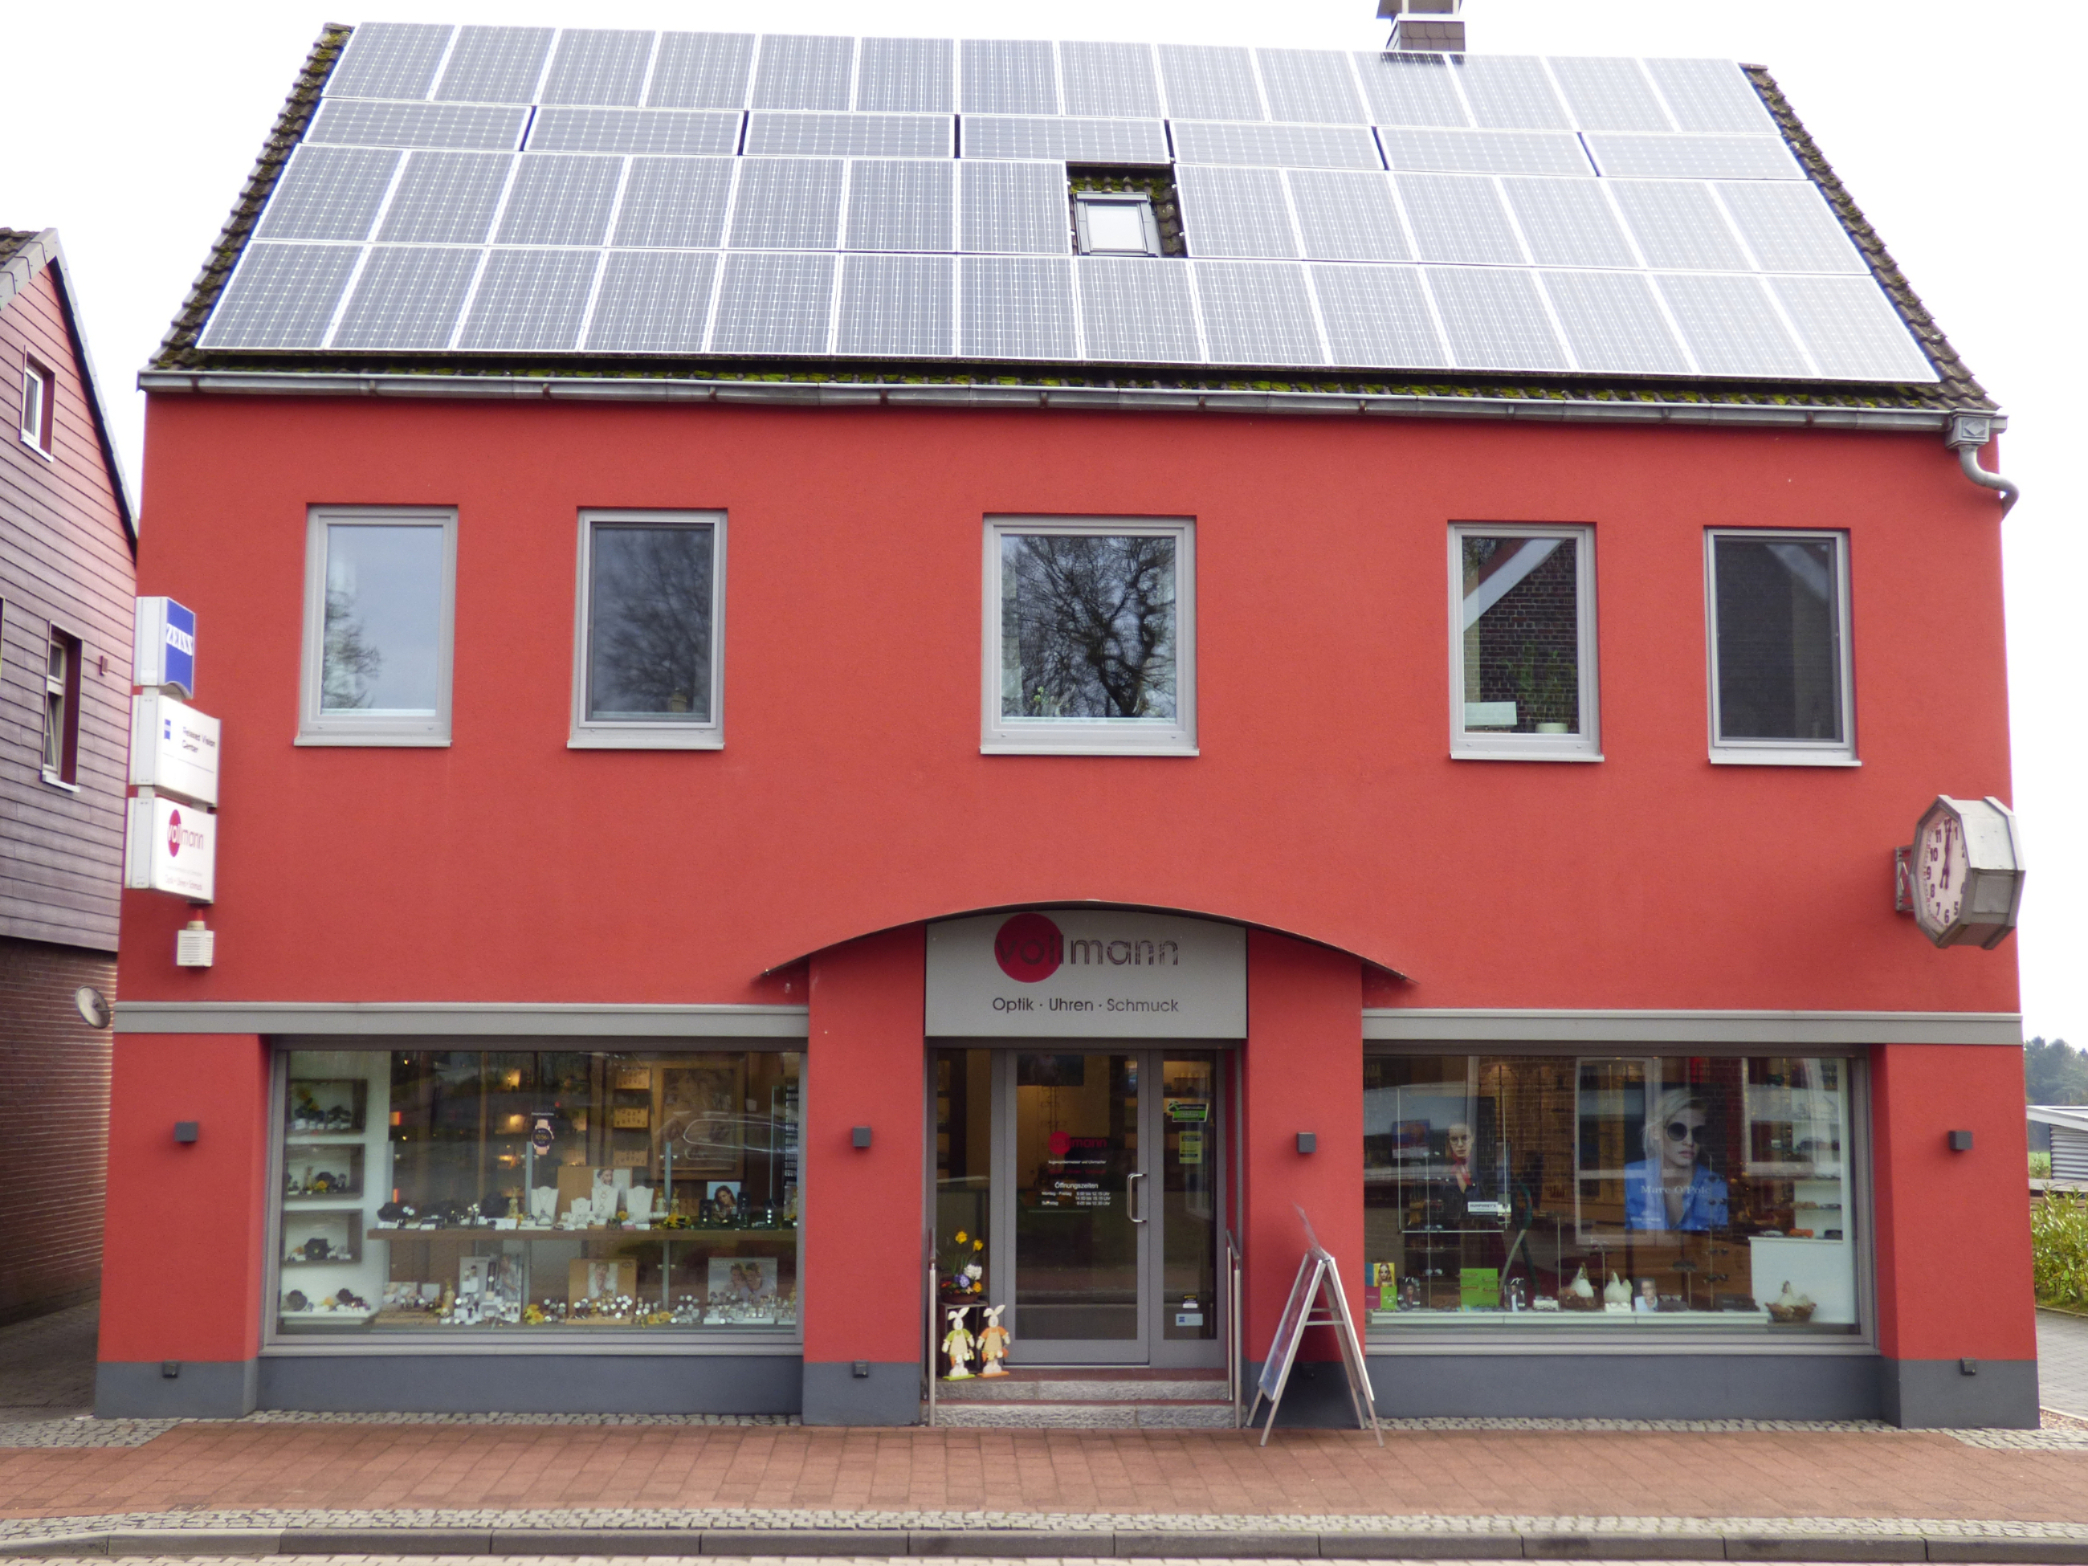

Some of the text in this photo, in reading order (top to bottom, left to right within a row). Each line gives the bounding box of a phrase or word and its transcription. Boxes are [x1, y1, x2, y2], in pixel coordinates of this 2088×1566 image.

[166, 623, 193, 656] ZEISS
[167, 824, 204, 850] vollmann
[1935, 829, 1942, 843] 11
[1954, 827, 1959, 840] 1
[1930, 847, 1938, 861] 10
[1926, 866, 1931, 880] 9
[1930, 883, 1935, 898] 8
[1936, 902, 1941, 915] 7
[1953, 901, 1959, 916] 5
[1943, 909, 1950, 923] 6
[995, 934, 1179, 966] vollmann
[992, 997, 1179, 1014] Optik Uhren Schmuck
[1054, 1181, 1099, 1190] Öffnungszeiten
[1640, 1185, 1671, 1194] Marc
